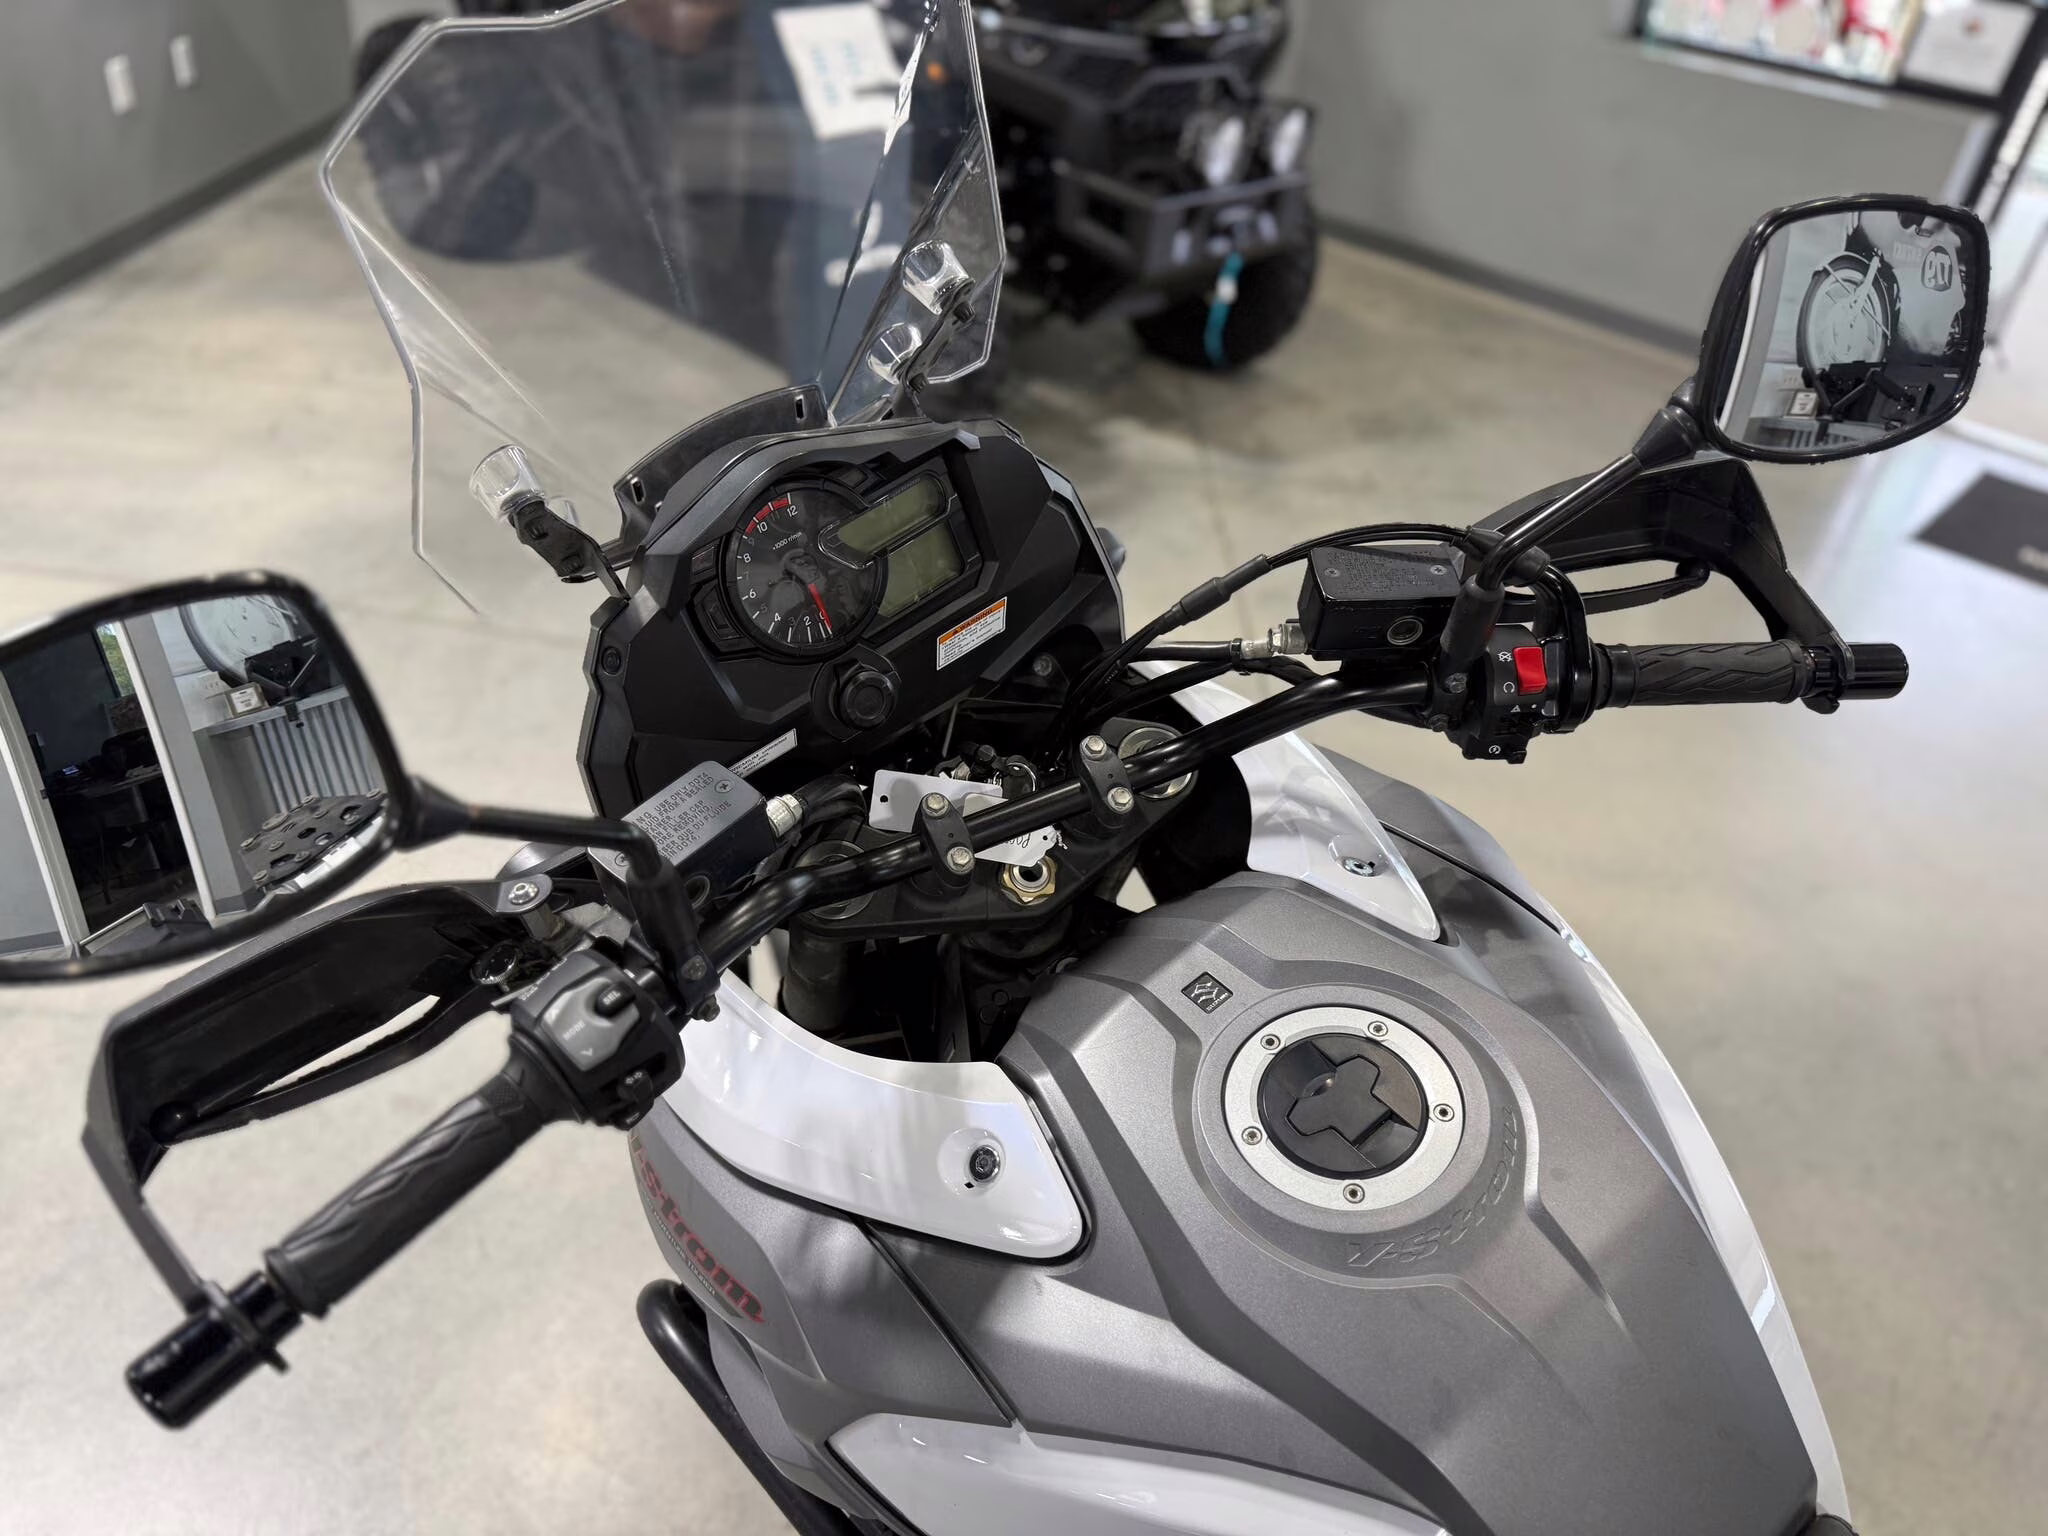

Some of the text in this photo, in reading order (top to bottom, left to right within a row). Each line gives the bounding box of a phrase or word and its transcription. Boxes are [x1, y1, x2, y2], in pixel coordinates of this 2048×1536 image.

[787, 505, 798, 517] 12
[757, 521, 768, 533] 10
[743, 553, 751, 563] 8
[749, 588, 757, 598] 6
[774, 612, 781, 622] 4
[803, 616, 812, 626] 2
[654, 798, 671, 812] USE
[670, 785, 689, 800] ONLY
[658, 800, 680, 817] FROM
[685, 776, 715, 798] SEALED
[662, 810, 690, 832] FILLER
[676, 827, 694, 841] QUE
[692, 820, 705, 830] DU
[703, 800, 732, 822] FLUIDE
[603, 990, 621, 1006] SEL
